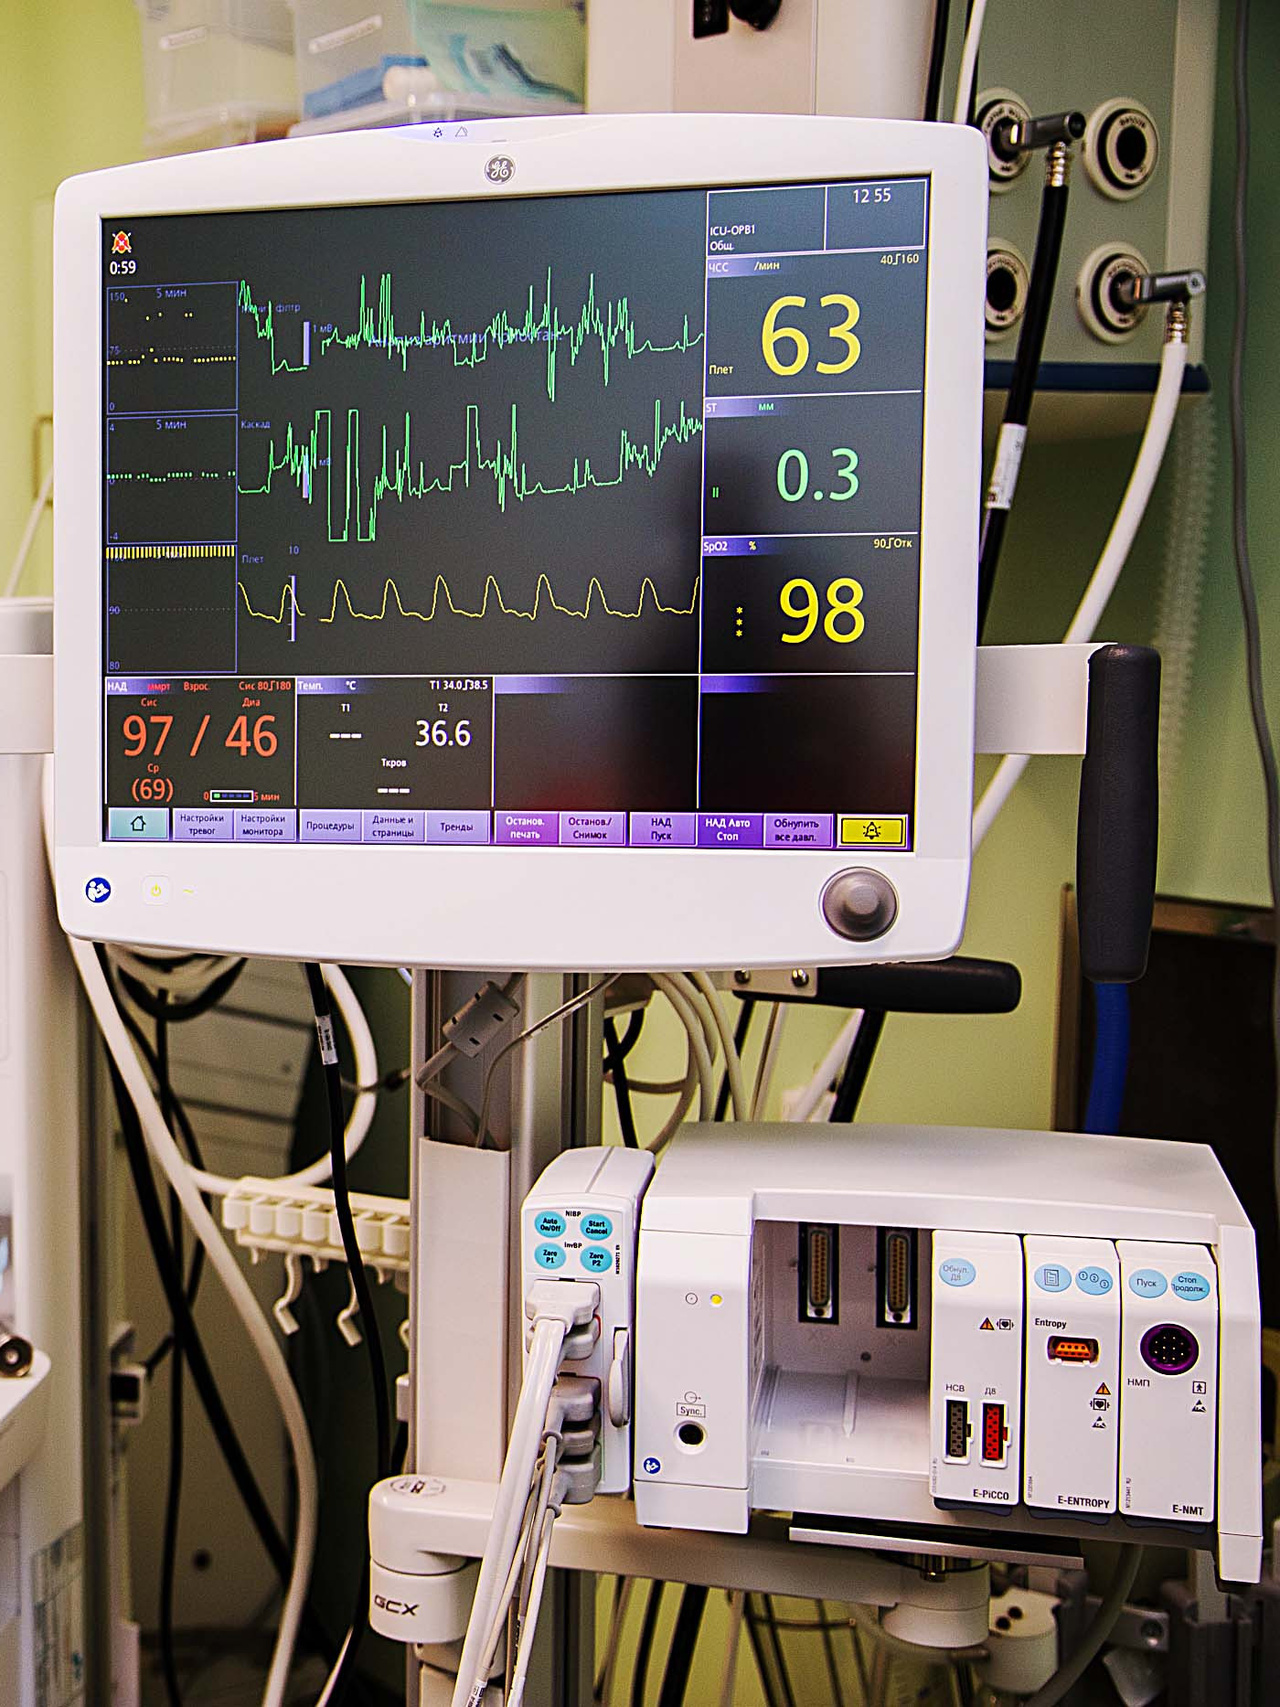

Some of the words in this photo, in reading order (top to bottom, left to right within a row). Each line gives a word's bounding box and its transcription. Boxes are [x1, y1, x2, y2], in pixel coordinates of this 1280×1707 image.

[110, 260, 136, 275] 0:59
[709, 262, 728, 273] ЧСС
[110, 292, 125, 301] 150
[166, 289, 187, 298] мин
[762, 294, 861, 376] 63
[709, 364, 734, 374] Плет
[706, 403, 718, 413] ST
[110, 423, 115, 432] 4
[166, 421, 186, 429] мин
[241, 420, 270, 430] Каскад
[776, 448, 860, 502] 0.3
[288, 546, 299, 554] 10
[704, 541, 728, 554] SpO2
[749, 541, 756, 550] %
[242, 554, 264, 564] Плет
[109, 606, 120, 615] 90
[780, 578, 865, 644] 98
[110, 661, 120, 670] 80
[108, 682, 128, 692] НАД
[239, 682, 255, 690] Сис
[141, 698, 158, 708] Сис
[242, 698, 260, 708] Диа
[342, 703, 350, 712] T1
[439, 703, 448, 712] T2
[123, 714, 174, 758] 97
[225, 714, 278, 758] 46
[416, 720, 471, 746] 36.6
[382, 758, 407, 769] Ткров
[147, 764, 160, 774] Ср
[132, 778, 174, 802] (69)
[180, 814, 224, 823] Настройки
[241, 814, 286, 824] Настройки
[372, 815, 405, 825] Данные
[407, 816, 414, 824] и
[506, 816, 545, 826] Останов.
[651, 818, 672, 828] НАД
[706, 818, 727, 828] НАД
[728, 819, 750, 828] Авто
[189, 827, 216, 836] тревог
[307, 821, 354, 832] Процедуры
[440, 822, 474, 832] Тренды
[242, 828, 283, 836] монитора
[372, 829, 414, 838] страницы
[510, 831, 540, 840] печать
[573, 830, 608, 840] Снимок
[651, 831, 672, 842] Пуск
[716, 832, 738, 842] Стоп
[774, 833, 790, 842] все
[540, 1224, 561, 1232] On/Off
[588, 1220, 605, 1228] Start
[586, 1227, 608, 1235] Cancel
[590, 1252, 604, 1260] Zero
[1136, 1278, 1157, 1288] Пуск
[1178, 1276, 1197, 1284] Стоп
[1035, 1318, 1067, 1330] Entropy
[1128, 1378, 1150, 1387] НМП
[680, 1406, 702, 1416] Sync.
[973, 1488, 1010, 1500] E-PiCCO
[1058, 1496, 1110, 1508] E-ENTROPY
[1172, 1504, 1204, 1516] E-NMT
[374, 1594, 419, 1616] GCX
